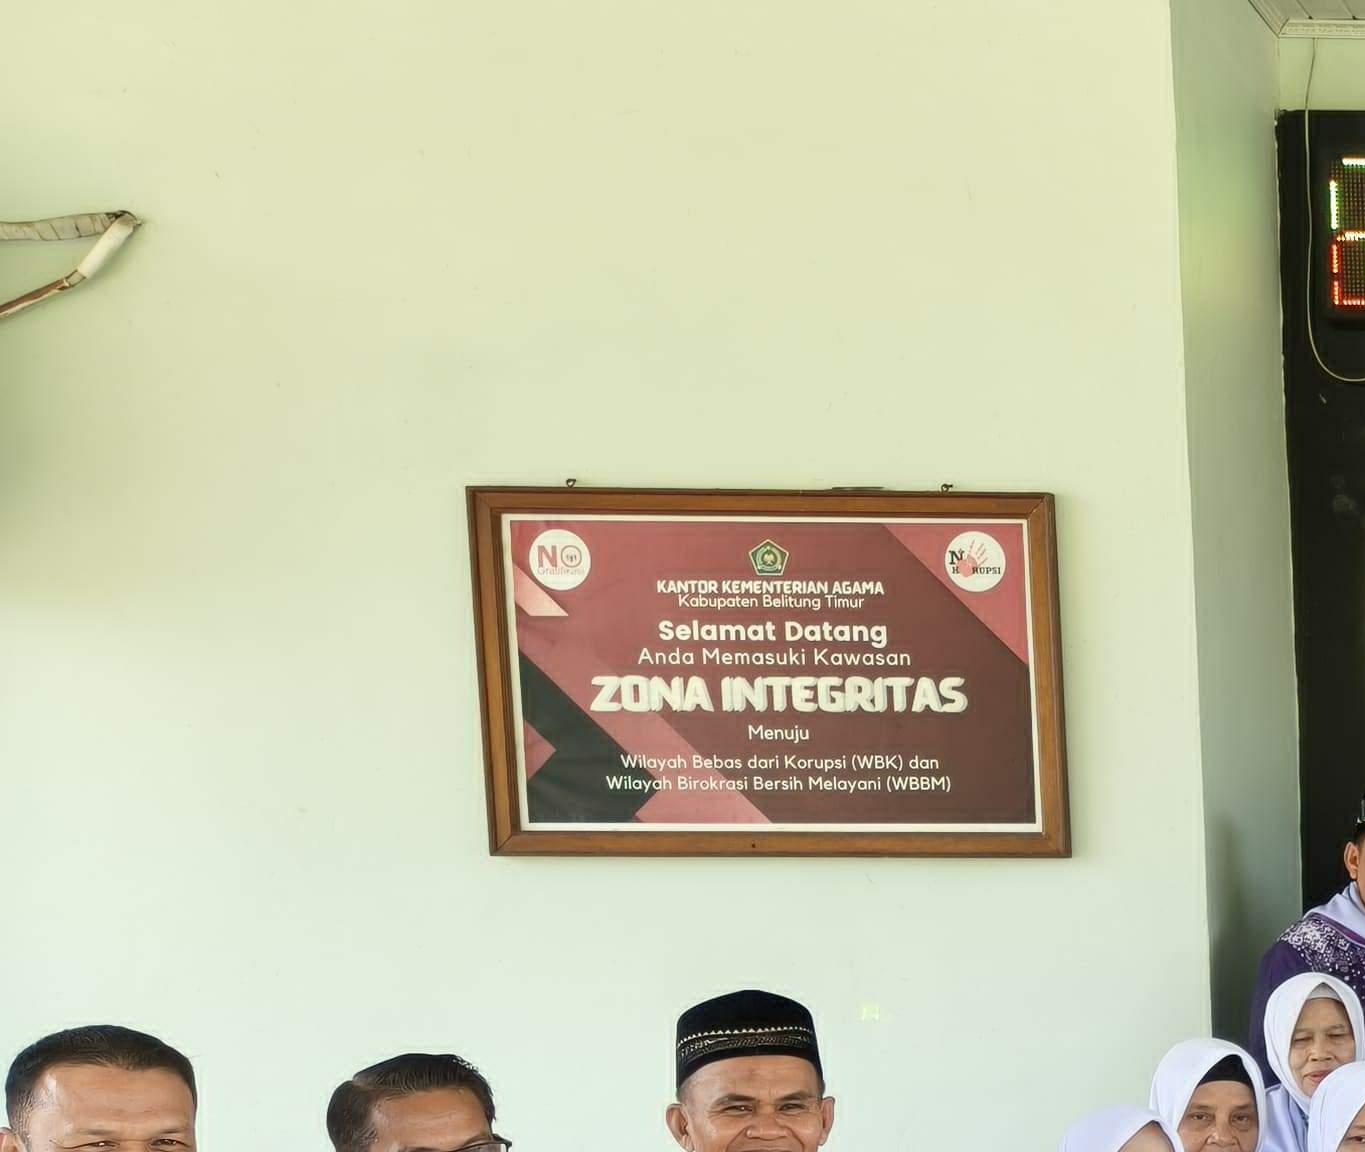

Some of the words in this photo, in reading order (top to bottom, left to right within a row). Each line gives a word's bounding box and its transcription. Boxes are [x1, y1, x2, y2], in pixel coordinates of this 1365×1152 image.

[656, 579, 718, 594] KANTOR
[721, 579, 829, 595] KEMENTERIAN
[831, 580, 885, 595] AGAMA
[678, 594, 759, 610] Kabupaten
[763, 594, 821, 611] Belitung
[824, 594, 865, 609] Timur
[657, 619, 777, 642] Selamat
[784, 620, 888, 649] Datang
[637, 647, 695, 666] Anda
[701, 647, 807, 666] Memasuki
[813, 648, 912, 667] Kawasan
[590, 675, 715, 713] ZONA
[720, 675, 969, 714] INTEGRITAS
[747, 724, 810, 744] Menuju
[620, 753, 687, 772] Wilayah
[692, 754, 743, 770] Bebas
[747, 754, 780, 770] dari
[784, 754, 847, 773] Korupsi
[850, 754, 903, 772] (WBK)
[908, 755, 940, 770] dan
[605, 775, 673, 794] Wilayah
[677, 775, 749, 792] Birokrasi
[752, 775, 804, 792] Bersih
[808, 775, 882, 794] Melayani
[885, 775, 952, 793] (WBBM)
